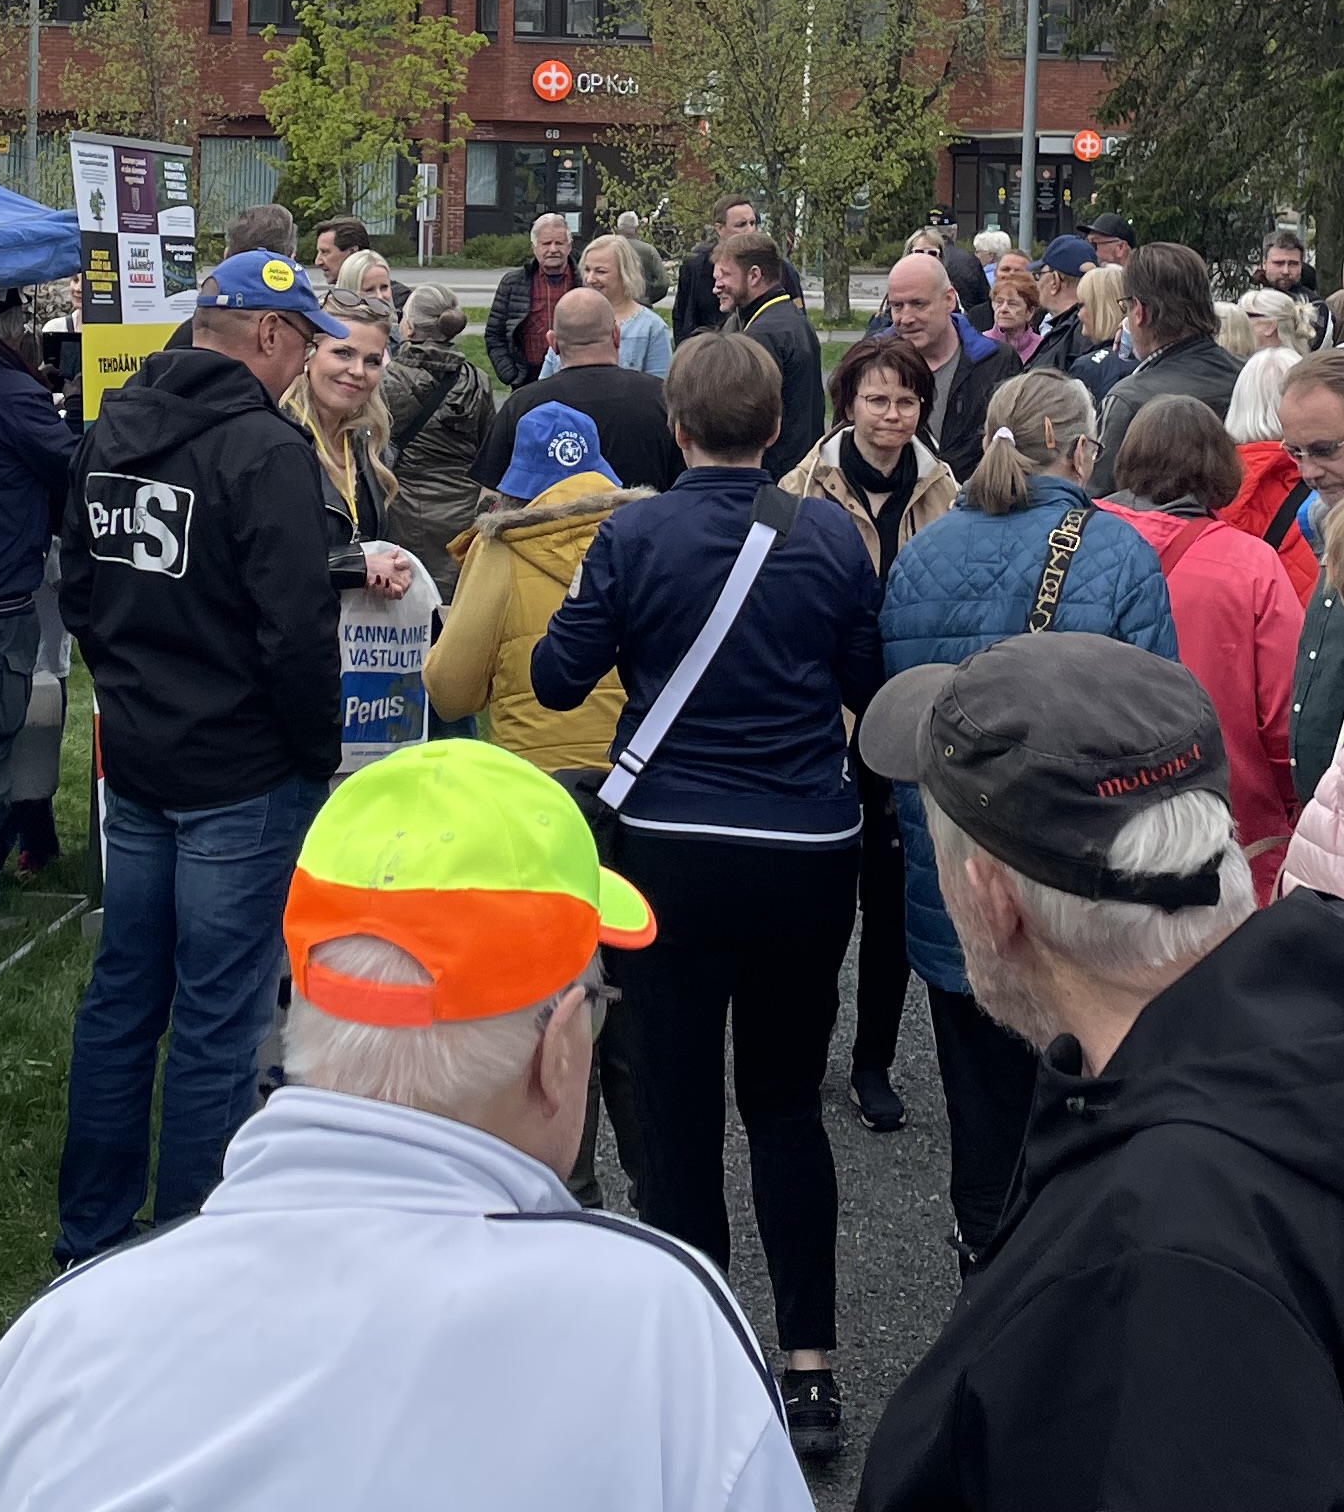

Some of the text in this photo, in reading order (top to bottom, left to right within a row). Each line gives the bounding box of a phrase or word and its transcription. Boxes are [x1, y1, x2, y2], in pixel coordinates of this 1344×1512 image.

[577, 72, 604, 93] OP
[98, 354, 138, 373] TEHDÄÄN
[344, 624, 428, 645] KANNAMME
[348, 648, 423, 668] VASTUUTA
